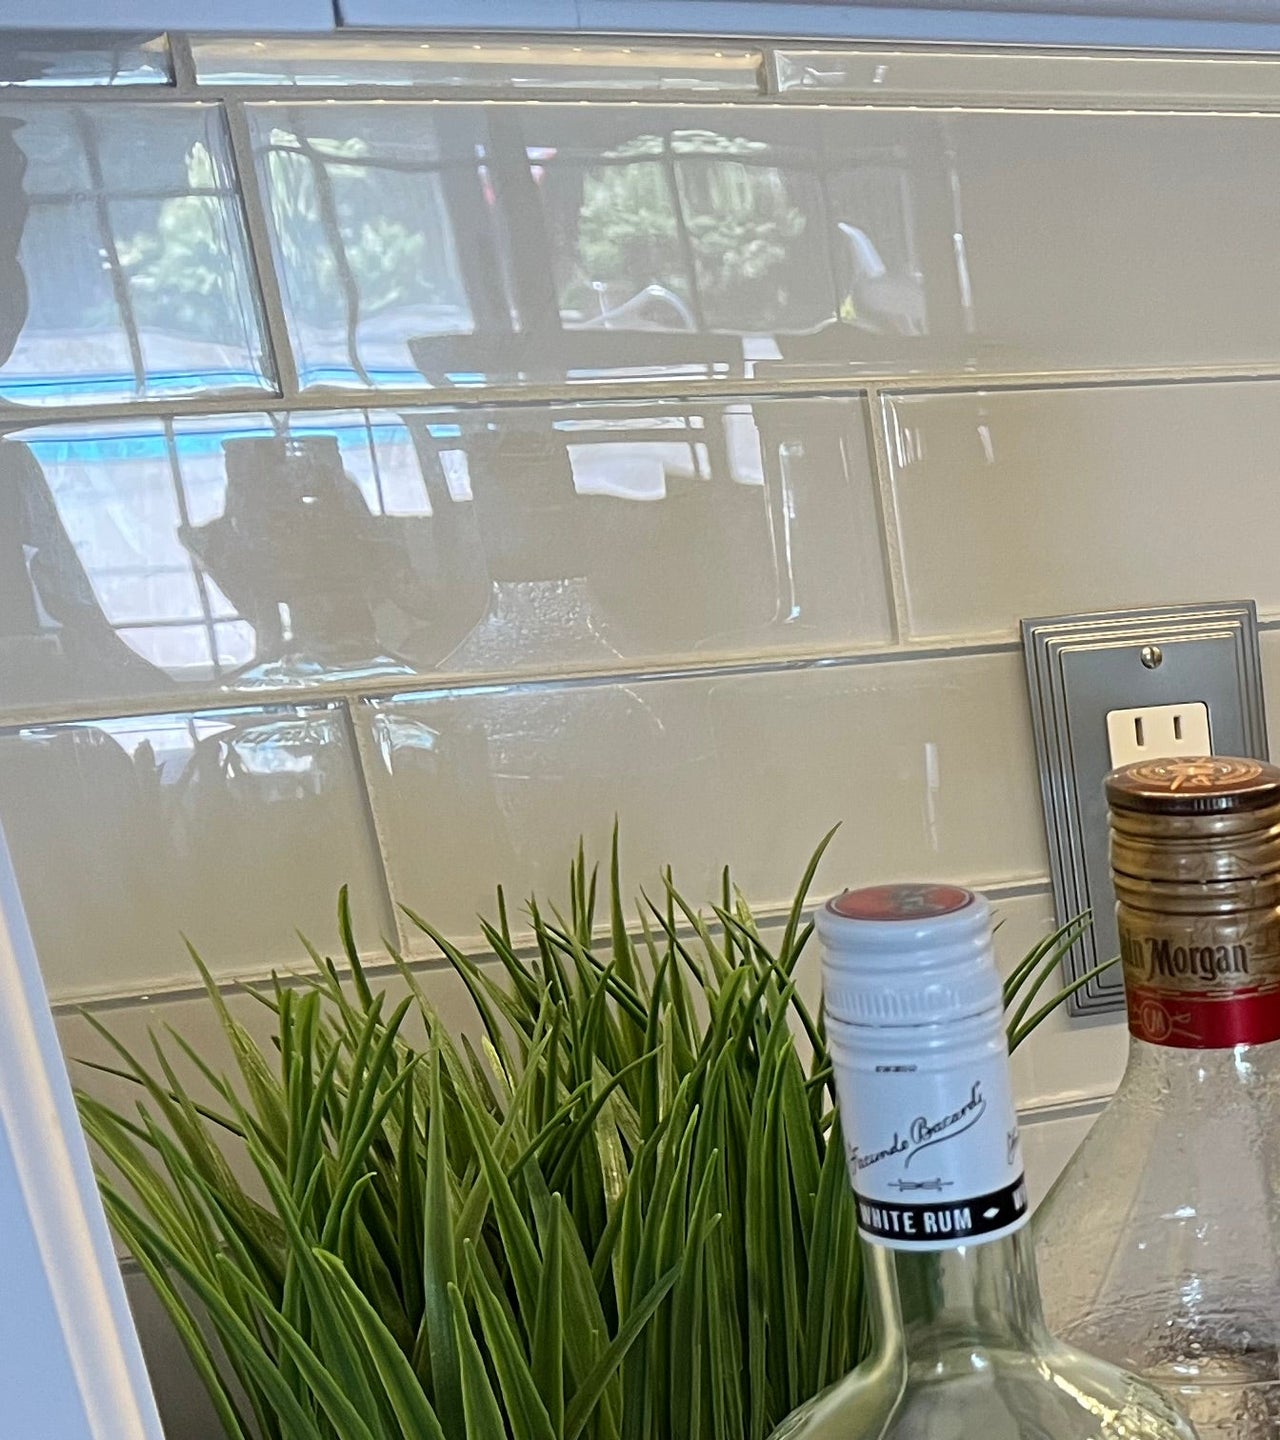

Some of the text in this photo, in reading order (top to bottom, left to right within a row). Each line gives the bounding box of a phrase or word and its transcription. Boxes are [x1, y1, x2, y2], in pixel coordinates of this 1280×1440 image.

[1145, 937, 1249, 981] Morgan
[858, 1201, 972, 1233] WHITE RUM
